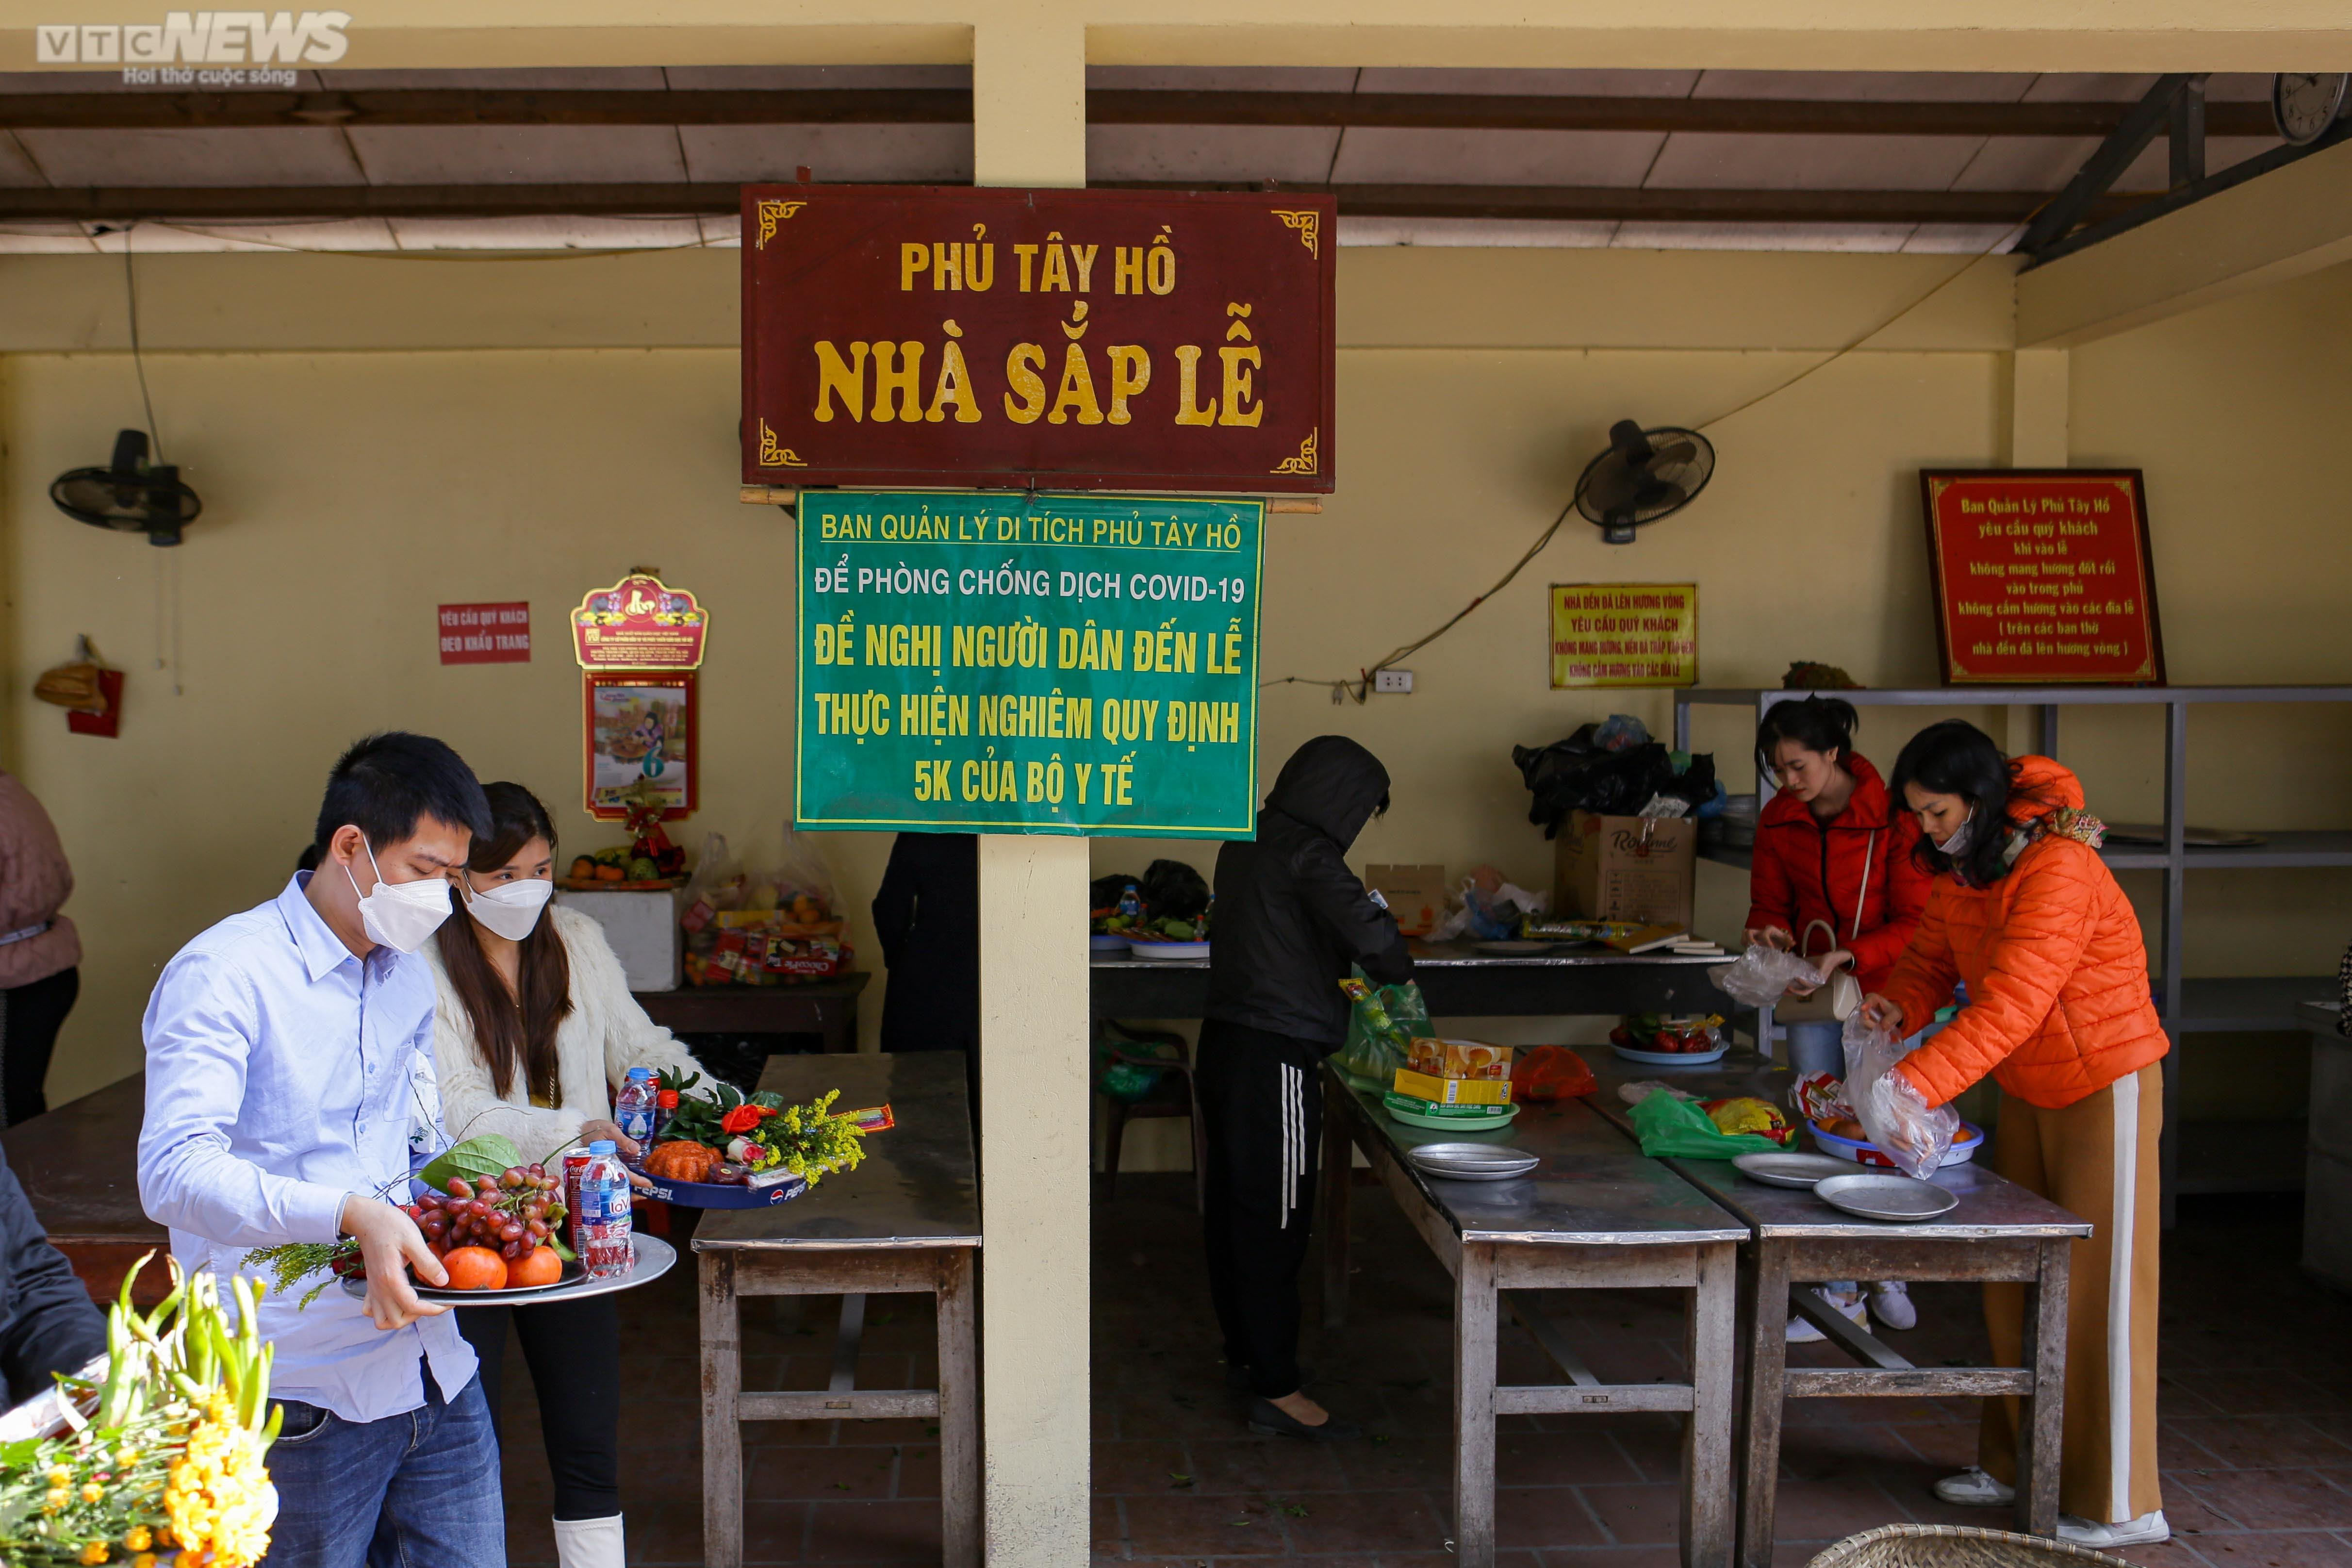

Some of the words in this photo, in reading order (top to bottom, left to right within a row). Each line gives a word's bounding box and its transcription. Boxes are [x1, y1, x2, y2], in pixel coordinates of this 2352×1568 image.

[902, 223, 993, 291] PHỦ
[1014, 232, 1099, 292] TÂY
[1115, 226, 1175, 295] HỒ
[814, 319, 982, 423] NHÀ
[1004, 300, 1151, 425] SẮP
[1175, 302, 1263, 428] LỄ
[1962, 498, 1984, 513] Ban
[1989, 498, 2018, 515] Quản
[2023, 498, 2036, 515] Lý
[2041, 498, 2064, 513] Phủ
[2068, 499, 2089, 515] Tây
[2094, 498, 2109, 513] Hồ
[822, 514, 871, 538] BAN
[881, 505, 949, 540] QUẢN
[959, 509, 990, 540] LÝ
[998, 517, 1020, 540] DI
[1026, 511, 1083, 545] TÍCH
[1092, 511, 1142, 546] PHỦ
[1151, 515, 1198, 546] TÂY
[1207, 514, 1240, 548] HỒ
[1979, 521, 2001, 538] yêu
[2007, 518, 2028, 535] cầu
[2033, 521, 2054, 538] quý
[2059, 521, 2097, 535] khách
[2014, 542, 2031, 555] khi
[2035, 544, 2054, 555] vào
[815, 554, 848, 593] ĐỂ
[859, 561, 949, 594] PHÒNG
[959, 559, 1049, 596] CHỐNG
[1060, 572, 1120, 602] DỊCH
[1130, 574, 1244, 603] COVID-19
[1971, 562, 2005, 577] không
[2009, 565, 2038, 577] mang
[2042, 562, 2075, 577] hương
[2007, 584, 2025, 594] vào
[2030, 583, 2058, 596] trong
[1958, 602, 1992, 617] không
[2023, 602, 2056, 616] hương
[2060, 604, 2078, 614] vào
[2083, 602, 2102, 614] các
[1644, 614, 1678, 631] KHÁCH
[2007, 623, 2030, 634] trên
[2035, 622, 2053, 634] các
[2057, 622, 2077, 634] ban
[495, 634, 529, 650] TRANG
[815, 610, 854, 665] ĐỀ
[866, 625, 940, 676] NGHỊ
[953, 616, 1047, 668] NGƯỜI
[1059, 620, 1123, 670] DÂN
[1134, 618, 1196, 673] ĐẾN
[1207, 618, 1242, 674] LỄ
[815, 690, 889, 744] THỰC
[901, 686, 968, 745] HIỆN
[979, 688, 1092, 739] NGHIÊM
[1102, 699, 1159, 745] QUY
[1168, 701, 1238, 752] ĐỊNH
[642, 746, 664, 777] 6
[915, 760, 952, 801] 5K
[962, 746, 1017, 802] CỦA
[1027, 753, 1064, 812] BỘ
[1075, 763, 1092, 804] Y
[1101, 751, 1136, 805] TẾ
